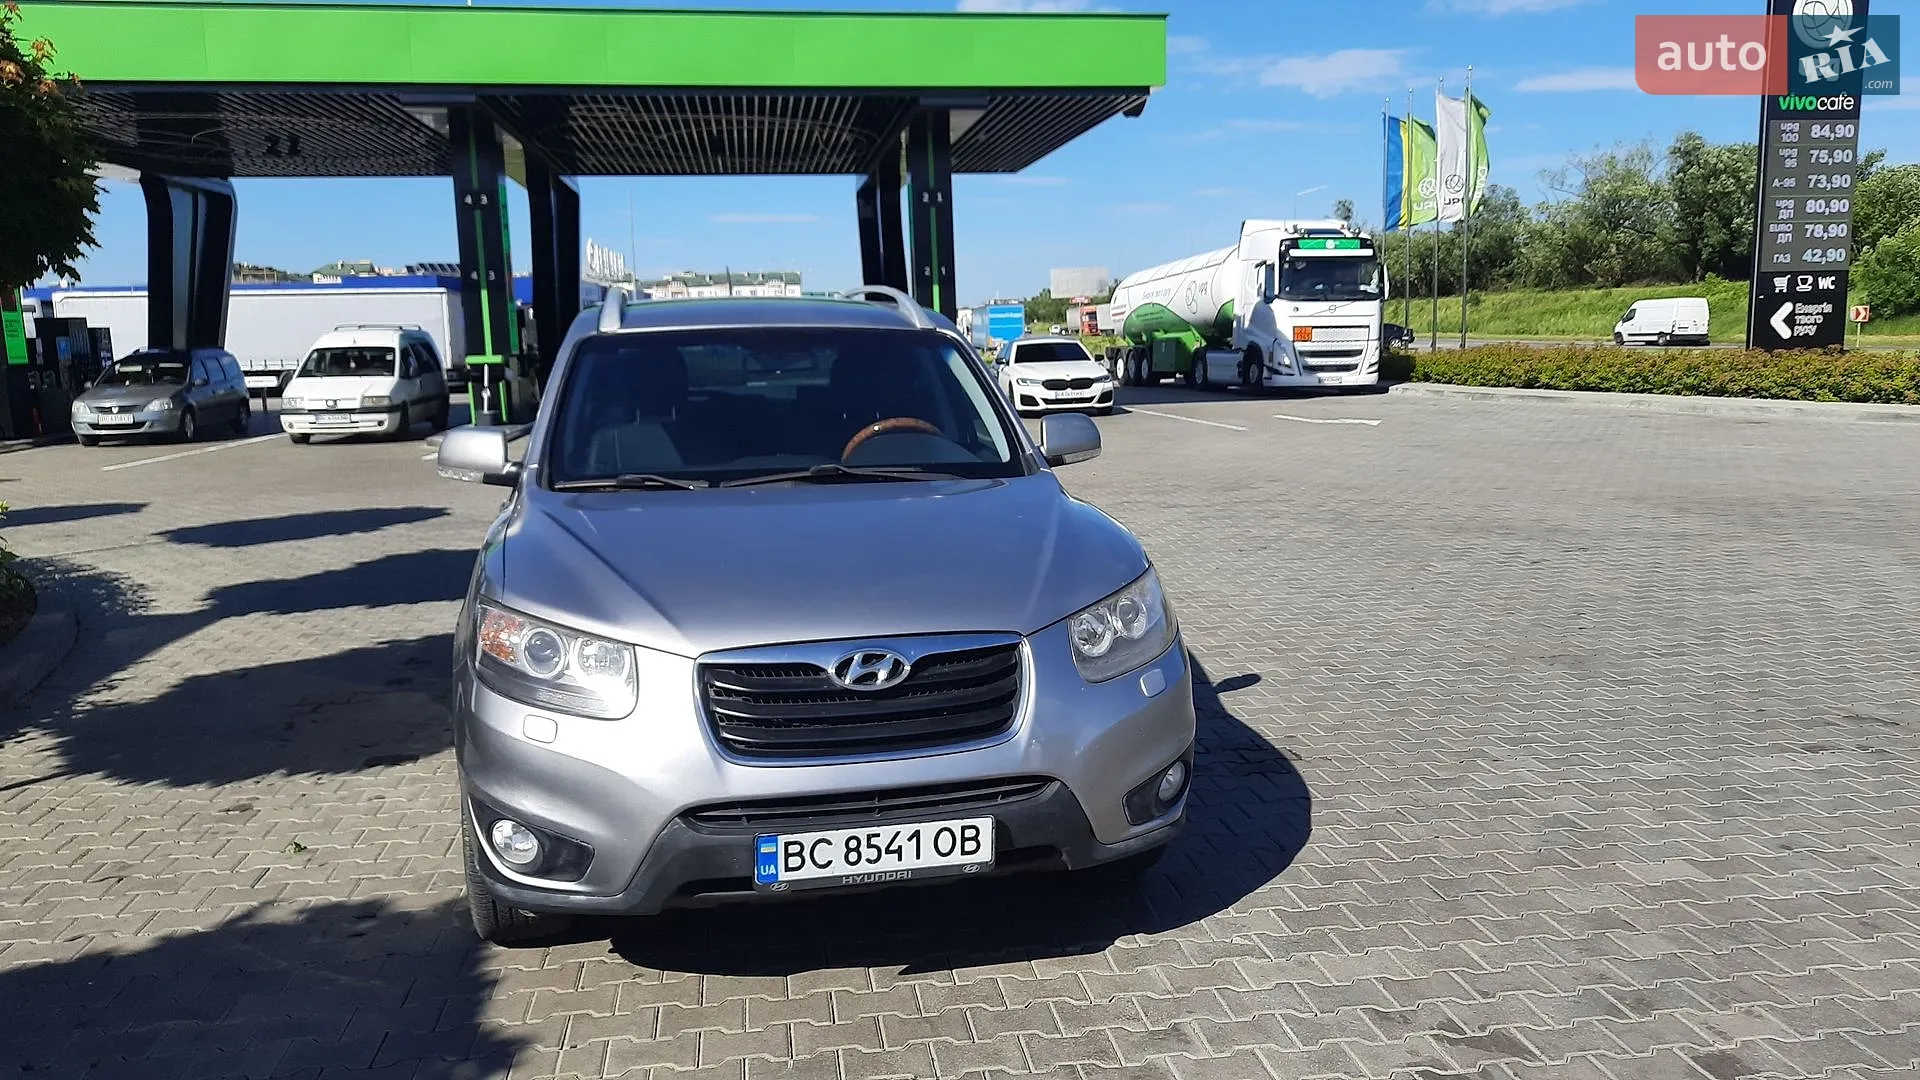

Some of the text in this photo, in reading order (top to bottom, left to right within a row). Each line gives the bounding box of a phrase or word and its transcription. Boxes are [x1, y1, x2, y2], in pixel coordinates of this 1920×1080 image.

[1780, 122, 1800, 132] upg
[1810, 124, 1855, 140] 84,90
[1781, 132, 1799, 142] 100
[1779, 148, 1798, 158] upg
[1809, 149, 1853, 165] 75,90
[1784, 158, 1798, 168] 95
[1808, 174, 1851, 190] 73,90
[464, 193, 489, 205] 4 3
[937, 192, 944, 202] 1
[1805, 199, 1850, 215] 80,90
[1778, 209, 1794, 219] ДП
[1769, 223, 1793, 233] EURO
[1804, 223, 1848, 240] 78,90
[1776, 233, 1793, 244] ДП
[1773, 248, 1847, 264] ГАЗ 42,90
[1817, 276, 1836, 290] WC
[783, 824, 981, 873] BC 8541 OB
[760, 864, 777, 876] UA
[842, 870, 912, 885] HYUNDAI
